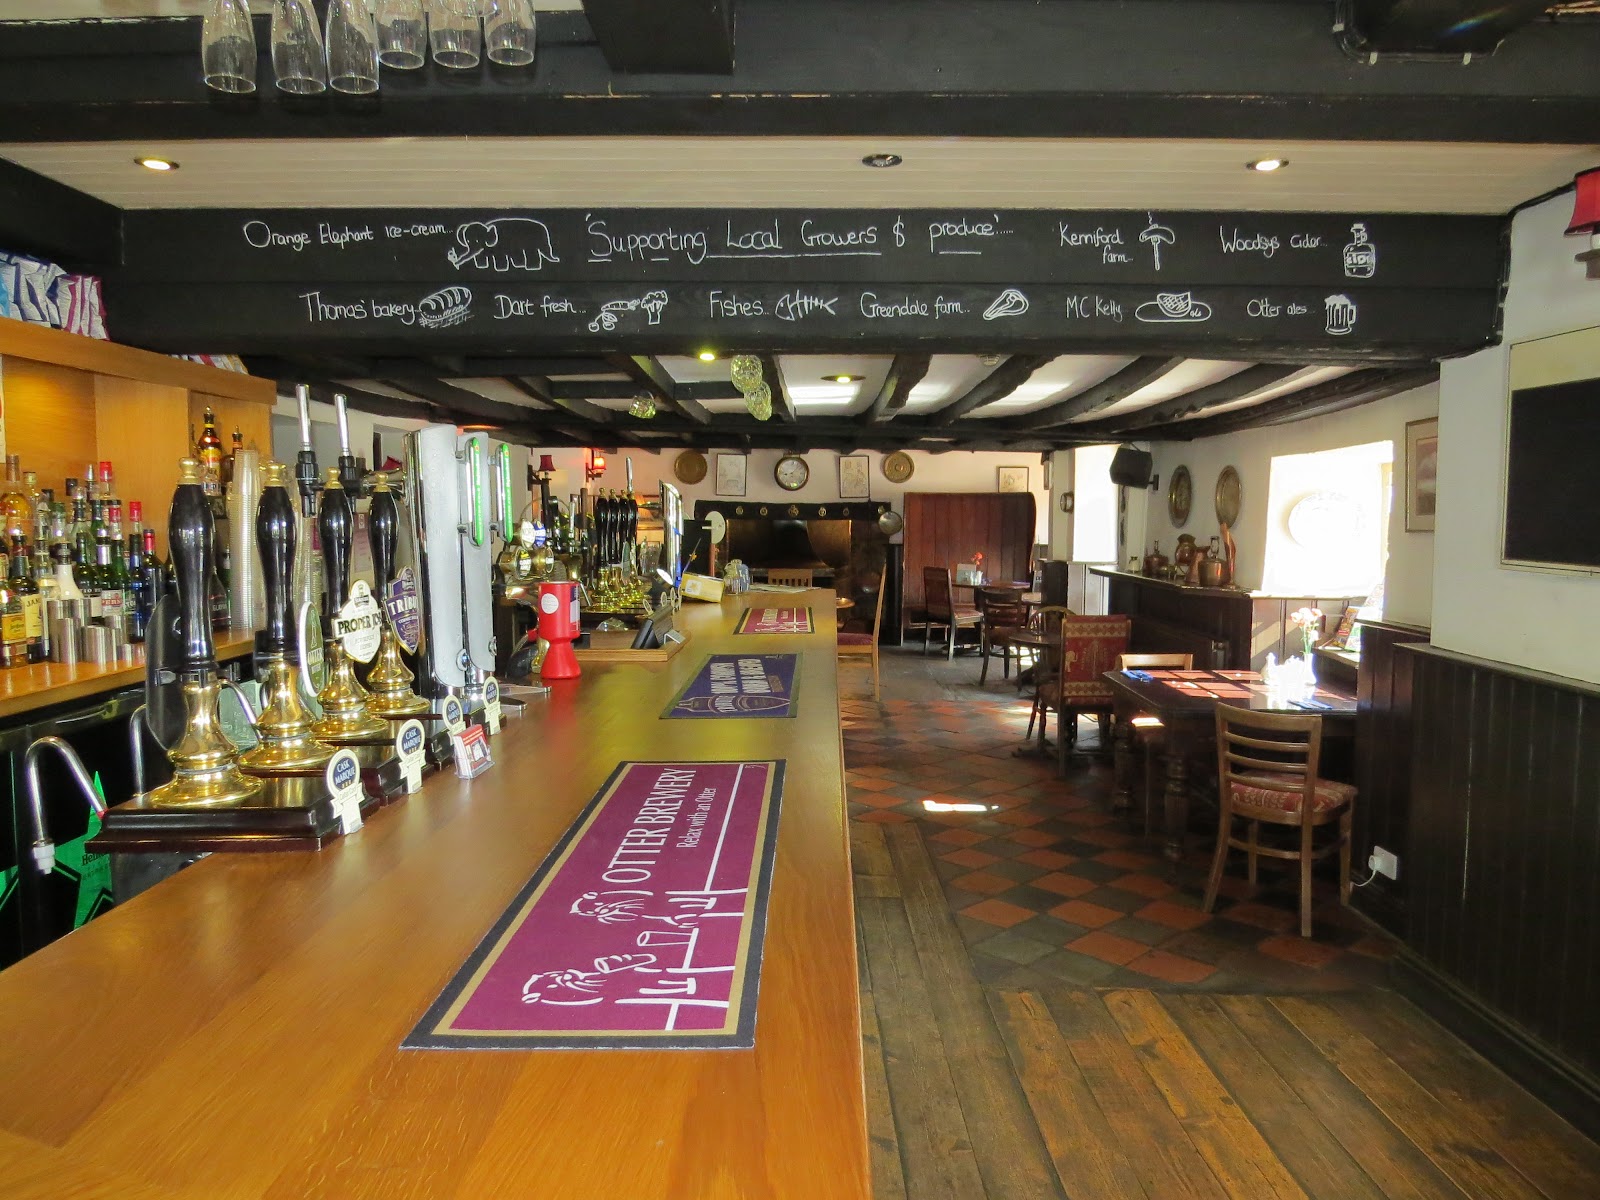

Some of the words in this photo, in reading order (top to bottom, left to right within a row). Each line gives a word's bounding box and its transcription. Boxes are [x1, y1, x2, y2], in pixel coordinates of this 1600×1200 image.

[243, 220, 312, 252] Orange
[319, 222, 374, 249] Elephant
[726, 218, 783, 250] Local
[801, 219, 878, 246] Growers
[892, 215, 905, 247] &
[494, 294, 534, 319] Dart
[860, 292, 930, 318] Greendale
[1247, 298, 1282, 318] Otter
[337, 615, 371, 636] PROPER
[335, 766, 356, 785] MARQUE
[336, 759, 351, 773] CASK
[633, 767, 697, 824] BREWERY
[695, 787, 717, 803] Otter
[696, 803, 712, 812] an
[686, 814, 708, 827] with
[676, 827, 703, 848] Relax
[602, 827, 672, 883] OTTER
